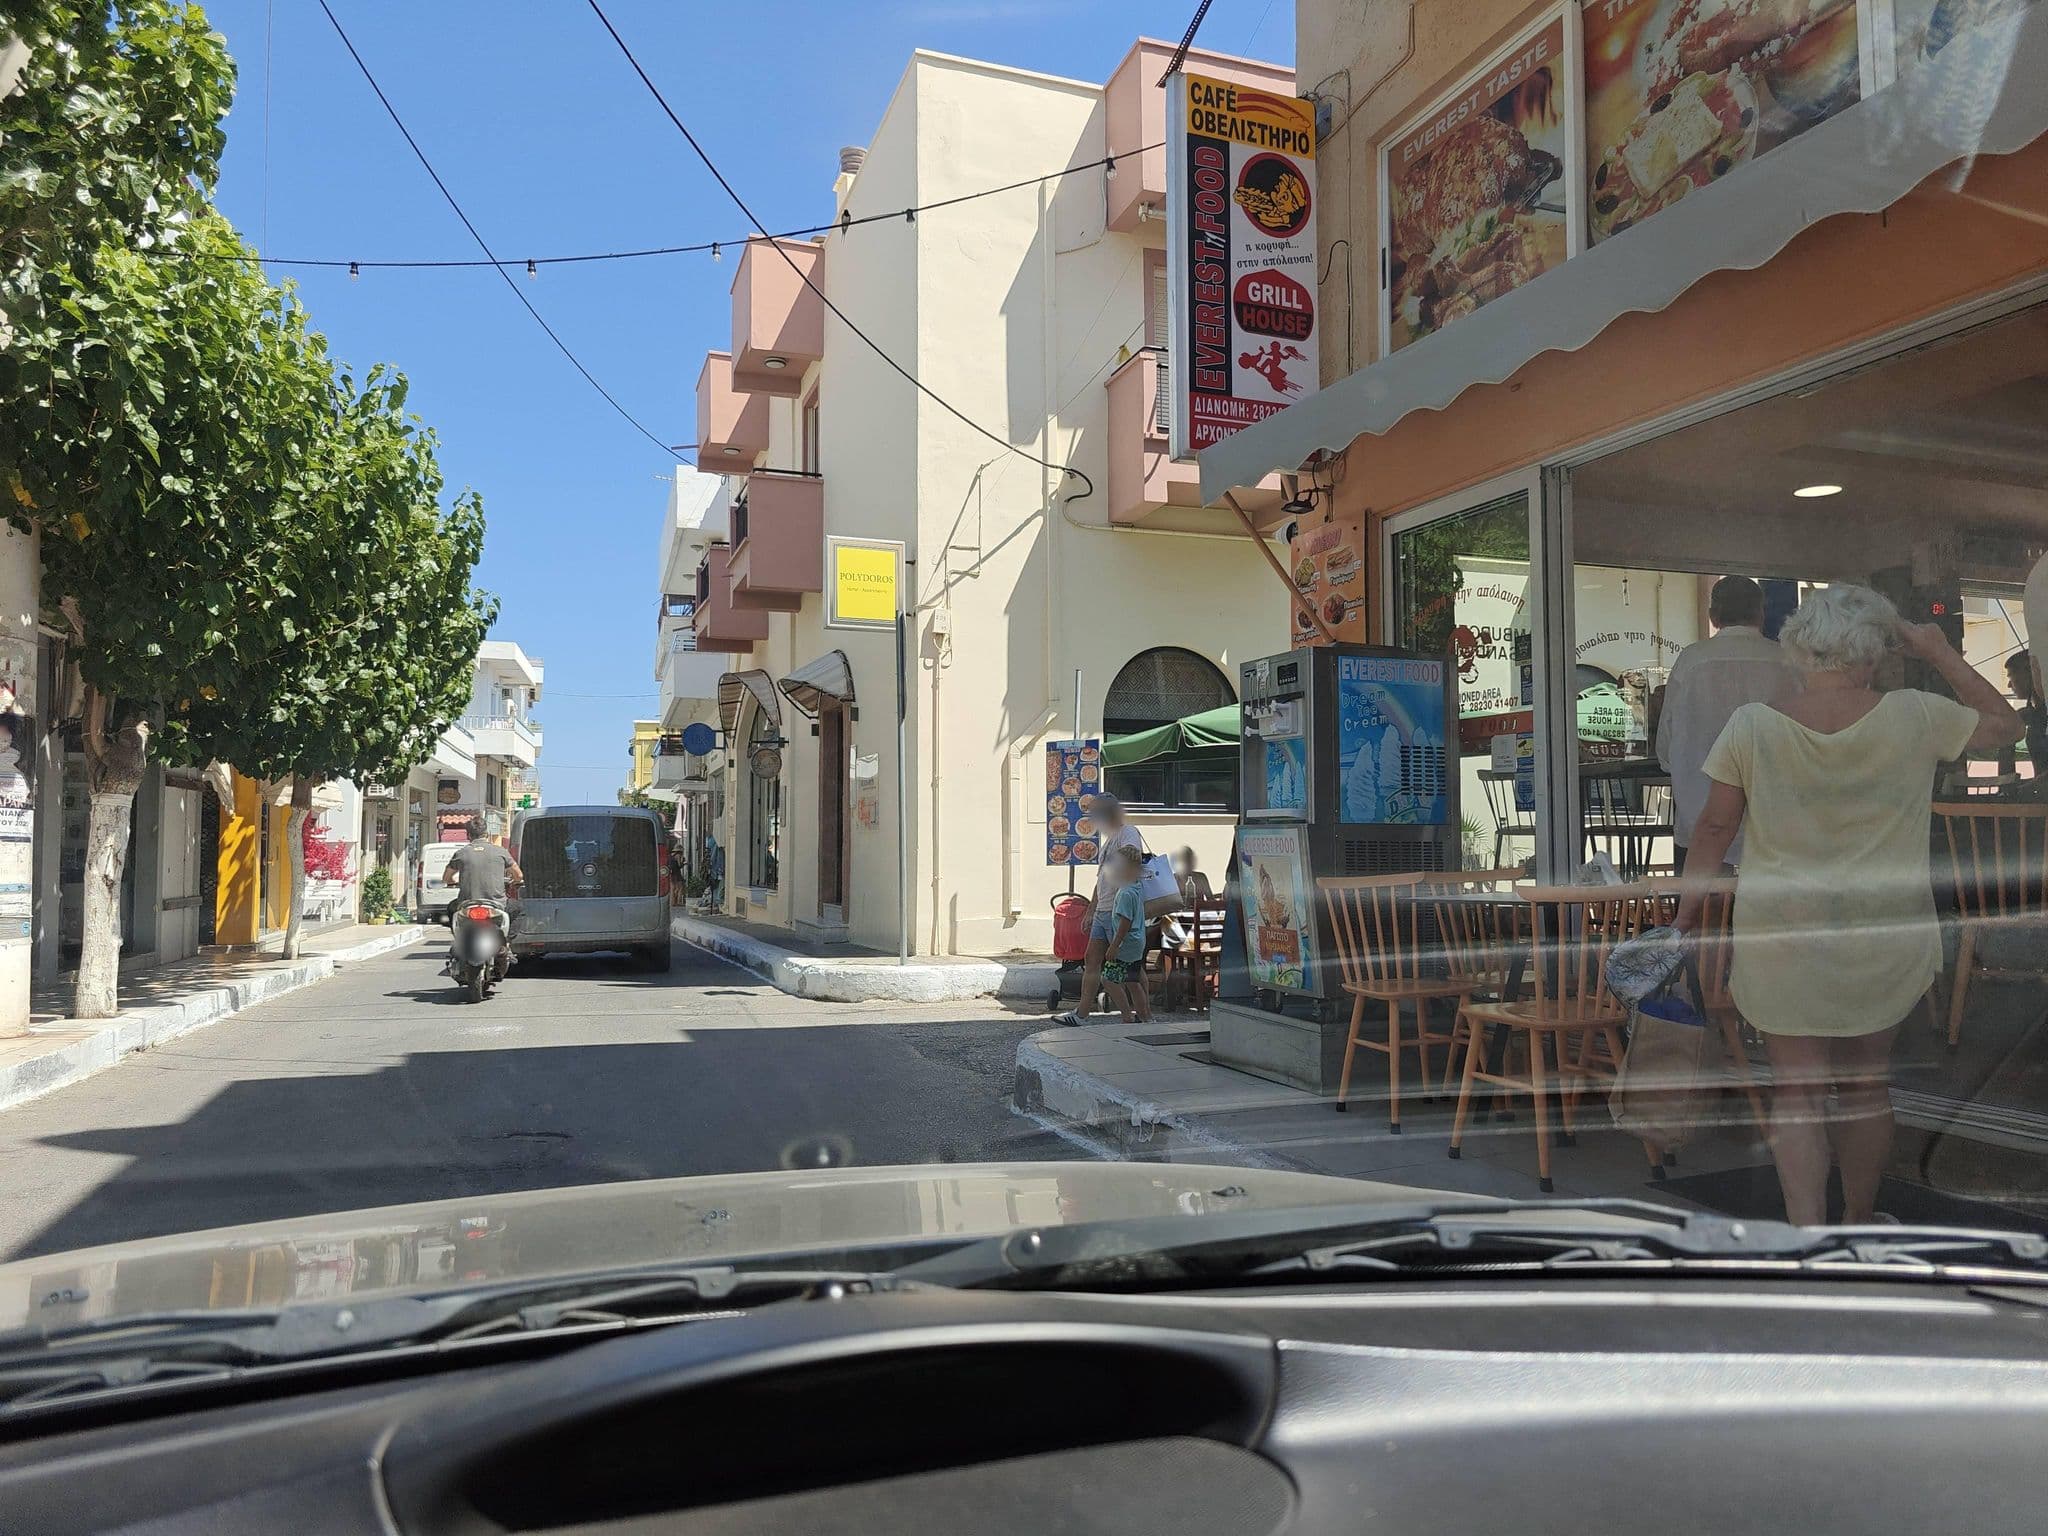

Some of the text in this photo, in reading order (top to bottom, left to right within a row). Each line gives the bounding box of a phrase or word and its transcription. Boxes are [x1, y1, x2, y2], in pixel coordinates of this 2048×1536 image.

[1190, 82, 1237, 113] CAFÉ
[1403, 38, 1548, 162] EVEREST TASTE
[1191, 108, 1310, 155] ΟΒΕΛΙΣΤΗΡΙΟ
[1194, 146, 1226, 391] EVEREST FOOD
[1236, 253, 1314, 269] στην απόλαυση!
[1247, 281, 1303, 310] GRILL
[1242, 305, 1307, 336] HOUSE
[1194, 396, 1250, 419] ΔΙΑΝΟΜΗ:
[1195, 423, 1241, 442] ΑΡΧΟΝΤ
[840, 572, 895, 584] POLYDOROS
[1476, 583, 1525, 614] απόλαυση
[1341, 658, 1440, 683] EVEREST FOOD
[1341, 690, 1386, 709] Dream
[1459, 687, 1502, 703] ONED AREA
[1469, 700, 1493, 713] 28230
[1495, 696, 1519, 709] 41407
[1344, 715, 1387, 732] Cream
[1275, 837, 1296, 854] FOOD
